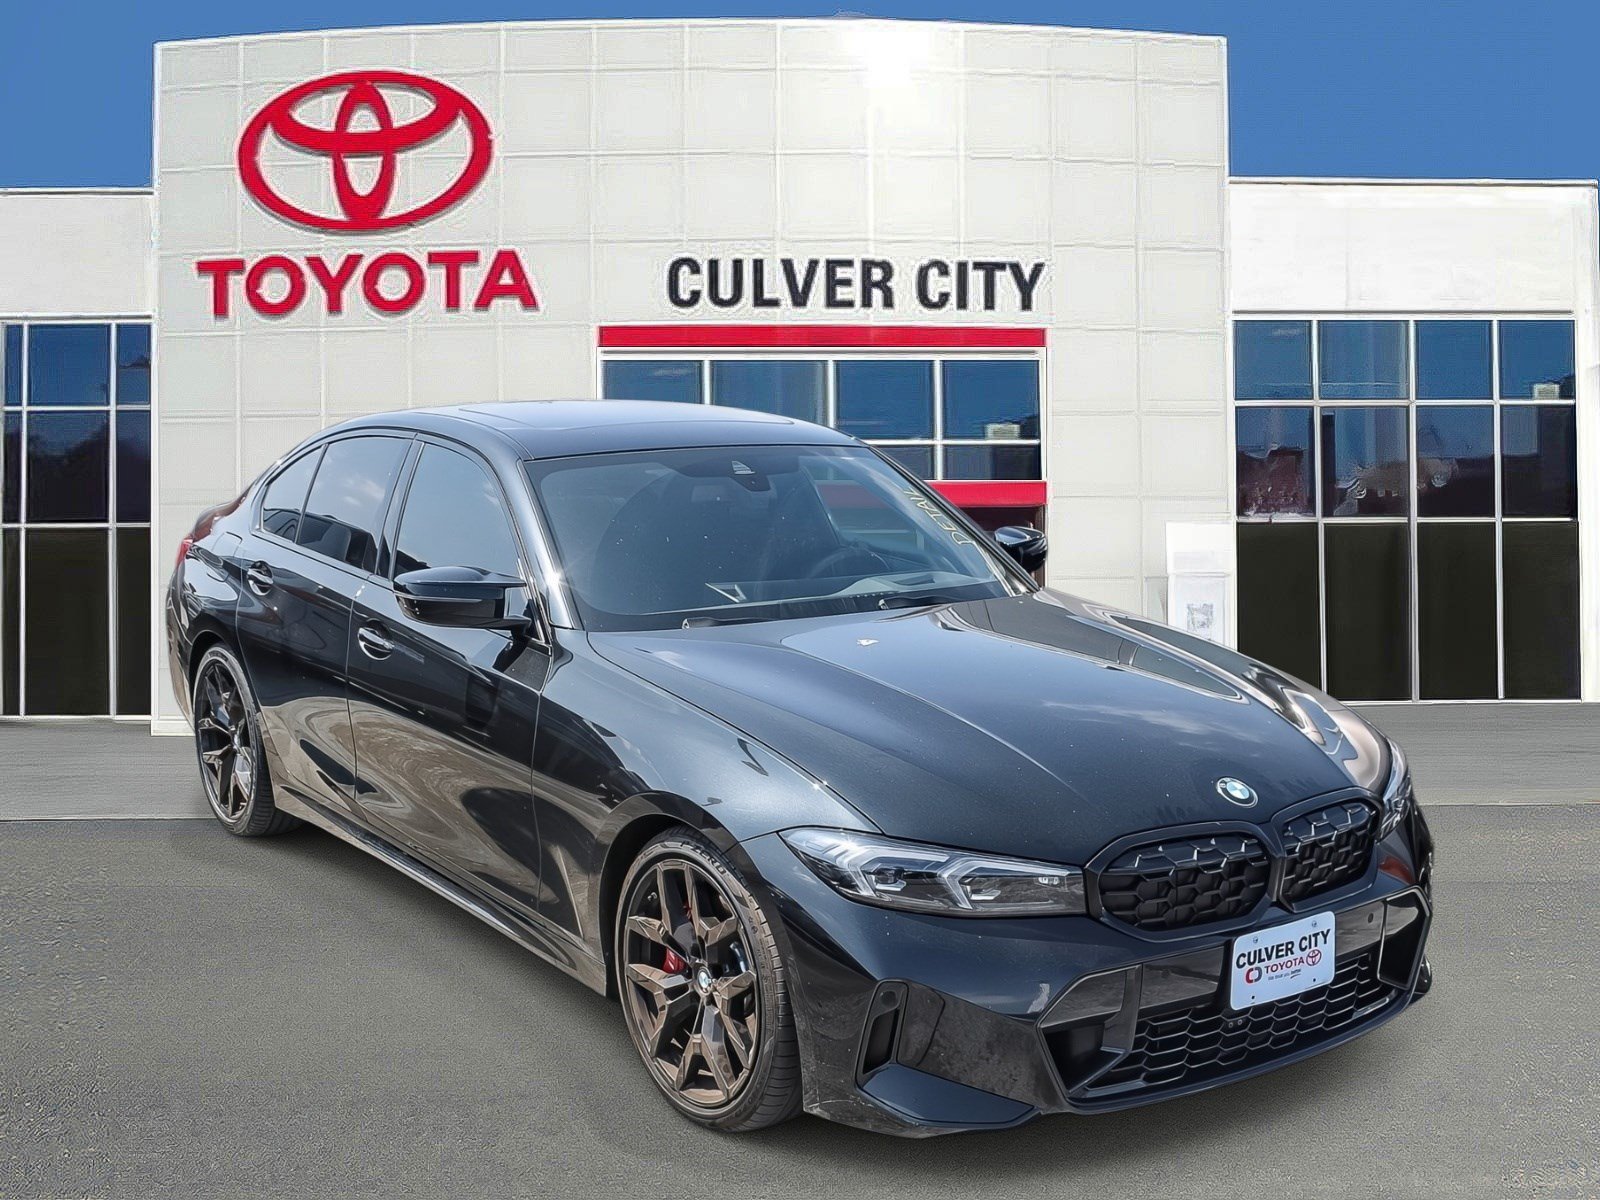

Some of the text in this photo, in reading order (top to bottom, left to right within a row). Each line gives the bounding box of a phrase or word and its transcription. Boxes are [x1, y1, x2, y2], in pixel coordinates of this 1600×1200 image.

[196, 250, 538, 317] TOYOTA
[668, 257, 1046, 311] CULVER CITY
[904, 486, 974, 545] DETAIL
[1236, 929, 1331, 969] CULVER CITY
[1265, 956, 1305, 974] TOYOTA
